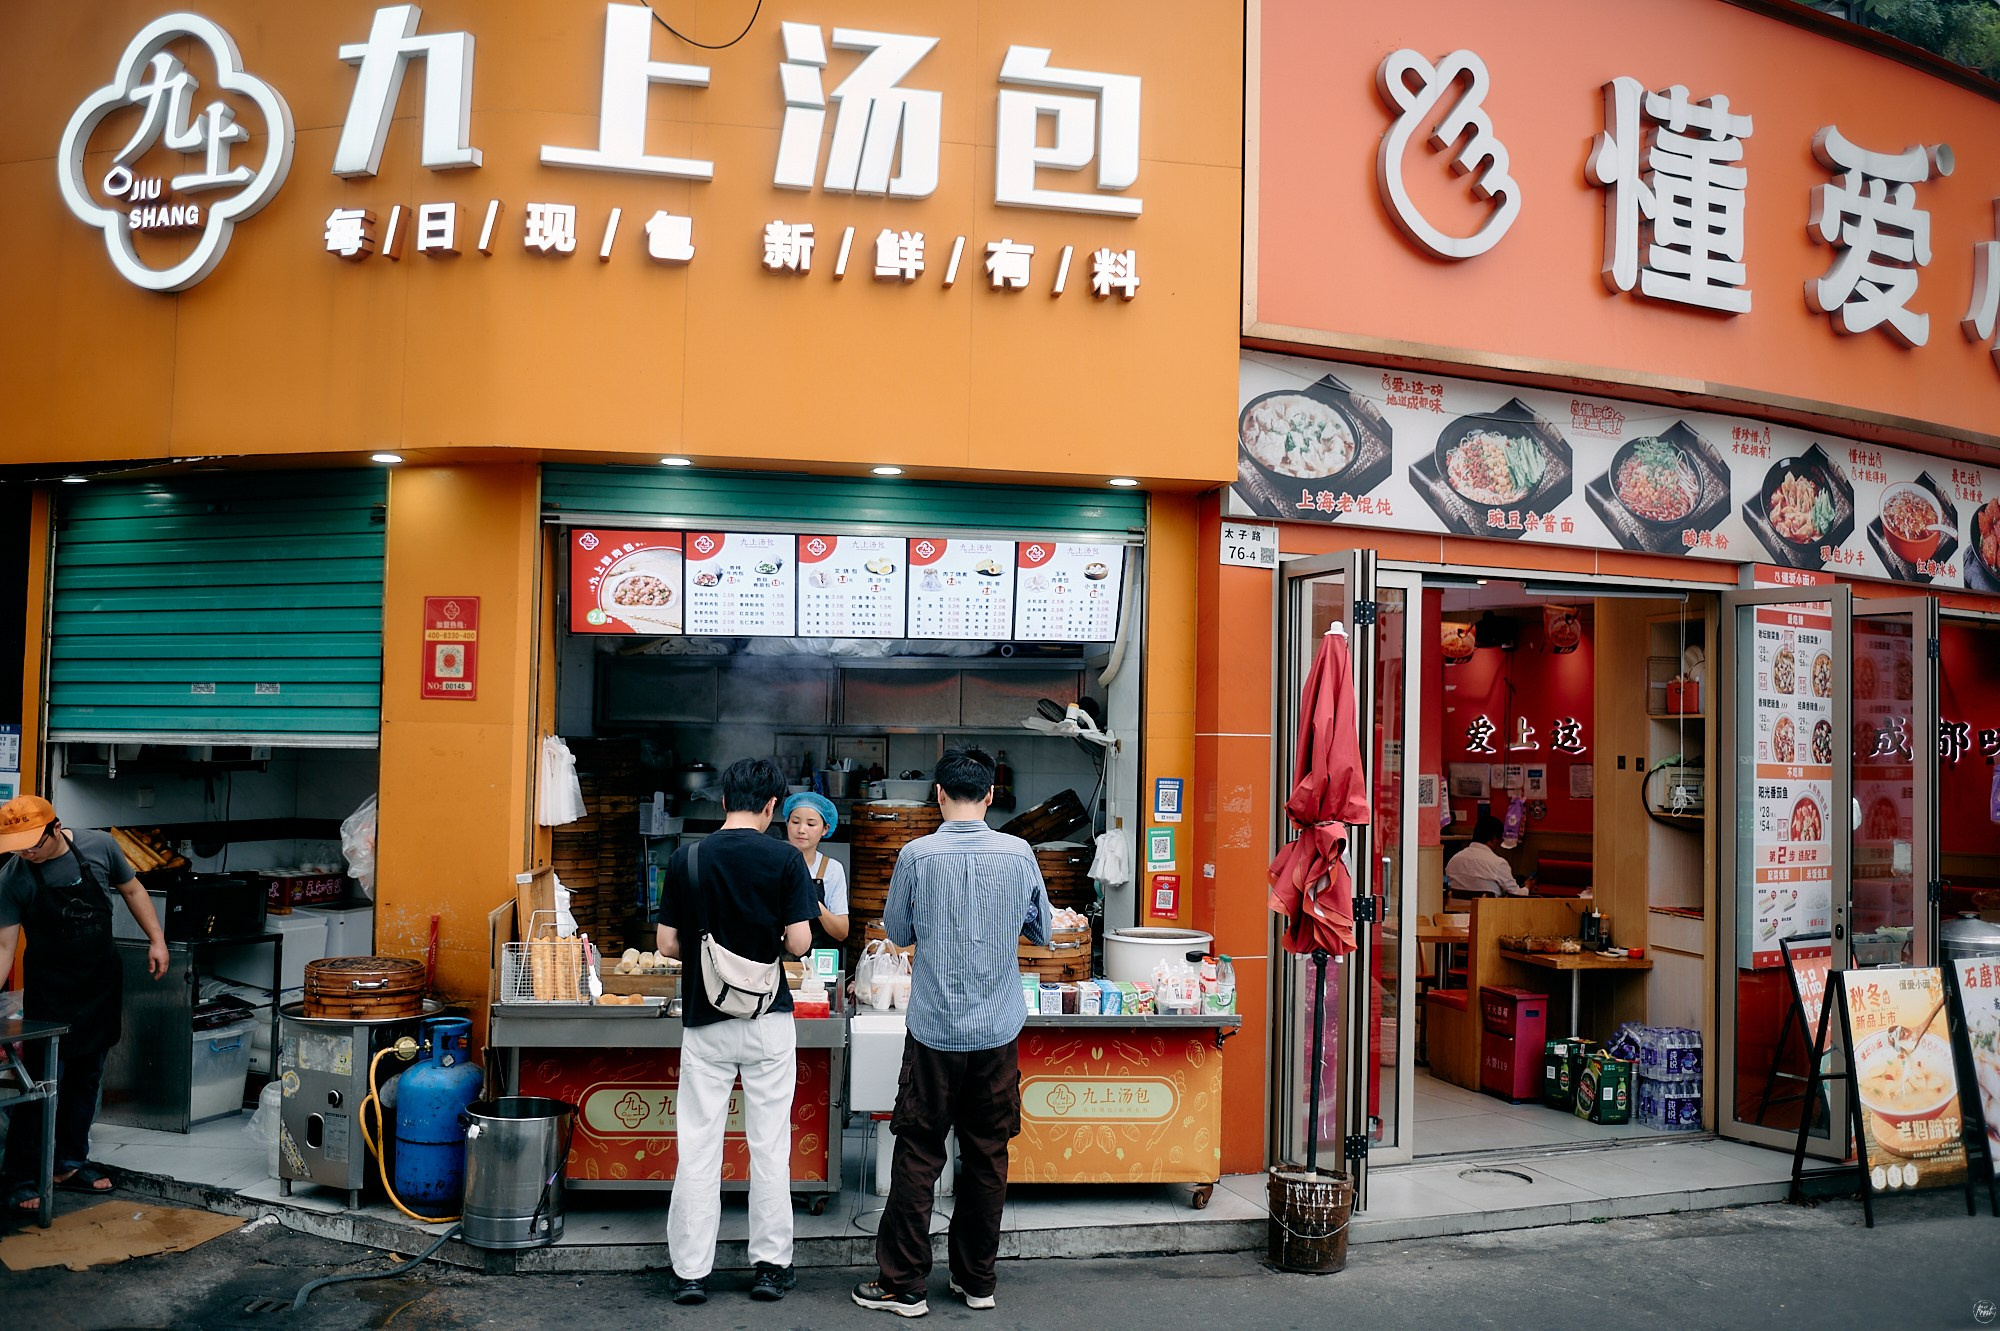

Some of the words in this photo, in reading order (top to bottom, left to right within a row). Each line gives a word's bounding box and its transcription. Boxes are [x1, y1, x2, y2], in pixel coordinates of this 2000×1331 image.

[331, 3, 1143, 218] 九上汤包
[113, 53, 255, 193] 九上
[130, 179, 163, 202] JIU
[128, 205, 200, 231] SHANG
[1392, 377, 1444, 398] 爱上这一碗
[1386, 394, 1445, 415] 地道成都味
[1848, 448, 1875, 468] 懂付出
[1858, 468, 1887, 485] 才能得到
[1951, 468, 1976, 487] 最巴适
[1296, 489, 1393, 516] 上海老馄饨
[1962, 487, 1983, 504] 最懂爱
[1487, 508, 1574, 534] 豌豆杂酱面
[852, 540, 886, 550] 九上汤包
[1224, 528, 1261, 542] 太子路
[1682, 528, 1730, 550] 酸辣粉
[960, 543, 993, 552] 九上汤包
[1068, 546, 1100, 555] 九上汤包
[1228, 546, 1256, 561] 76-4
[1820, 545, 1865, 567] 现包抄手
[1916, 558, 1957, 578] 红糖冰粉
[427, 631, 475, 639] 400-8330-400
[427, 682, 443, 690] NO:
[444, 682, 466, 690] 00145
[1465, 714, 1587, 755] 爱上这
[1758, 786, 1788, 799] 阳光番茄鱼
[1769, 846, 1796, 865] 第2步
[1767, 869, 1790, 881] 配菜免费
[1806, 869, 1828, 880] 米饭免费
[1898, 979, 1931, 991] 懂爱小面
[1849, 983, 1881, 1013] 秋冬
[1856, 1011, 1896, 1030] 新品上市
[656, 1095, 740, 1118] 九包
[1082, 1088, 1150, 1105] 九上汤包
[625, 1097, 646, 1117] 九上
[1896, 1117, 1960, 1142] 老妈蹄花
